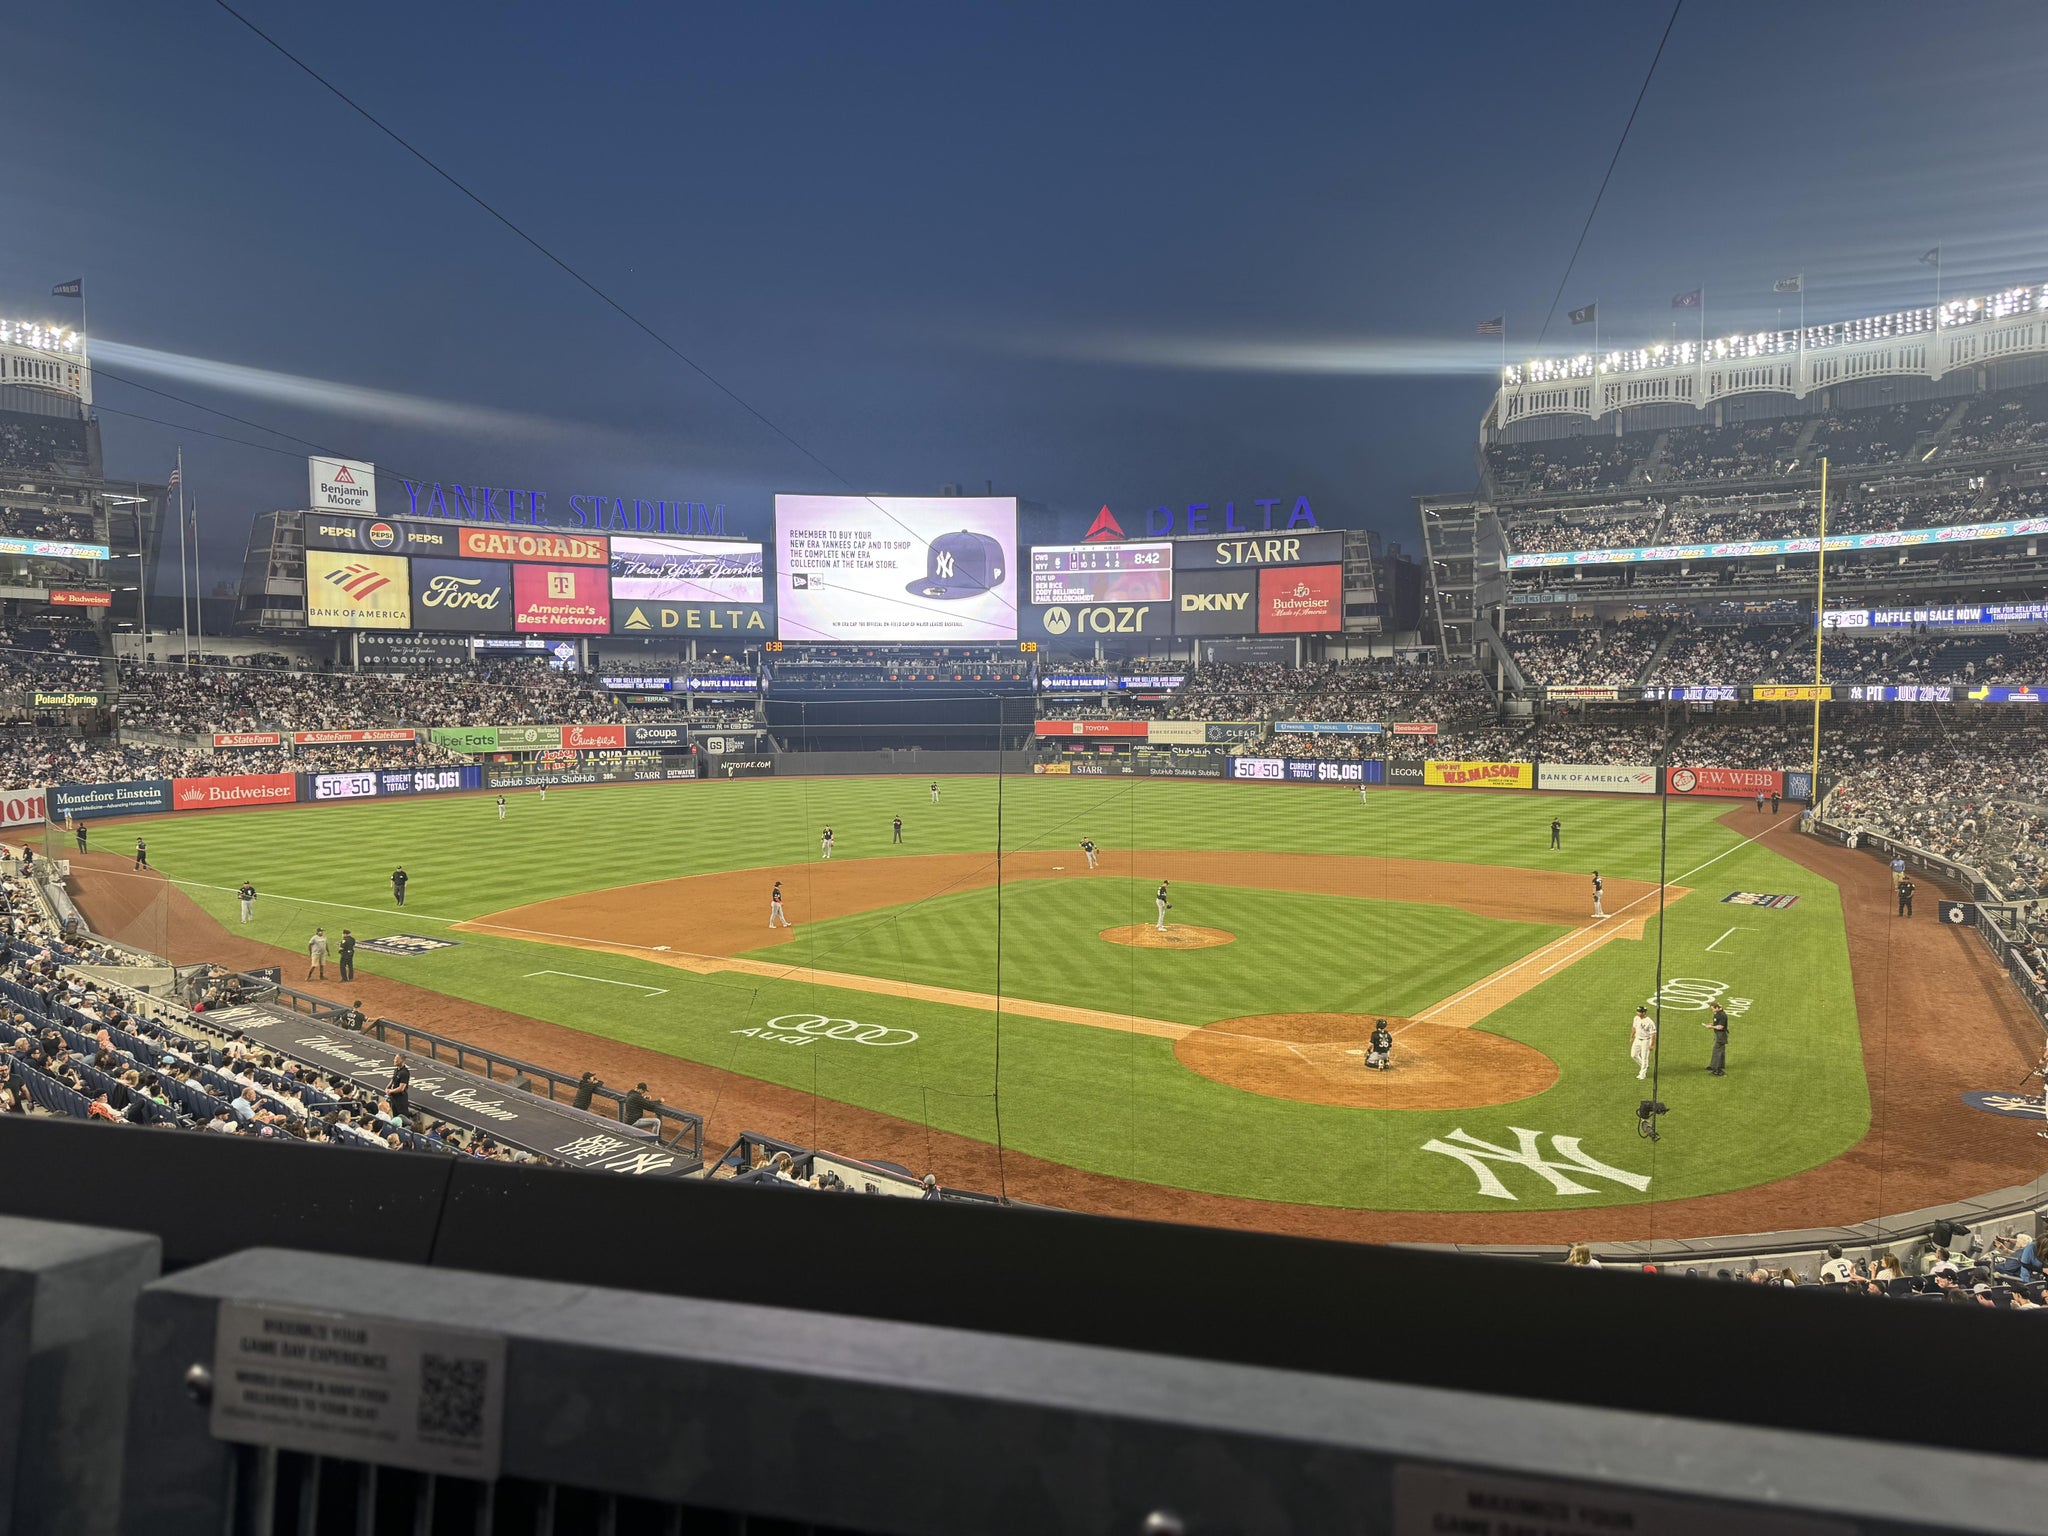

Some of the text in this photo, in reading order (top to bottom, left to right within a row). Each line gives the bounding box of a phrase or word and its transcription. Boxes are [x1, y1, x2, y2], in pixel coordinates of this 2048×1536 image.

[321, 482, 369, 498] Benjamin
[328, 494, 361, 506] Moore
[403, 480, 726, 535] YANKEE STADIUM
[1145, 496, 1318, 536] DELTA
[320, 526, 356, 538] PEPSI
[372, 530, 394, 540] PEPSI
[790, 530, 827, 538] REMEMBER
[408, 533, 443, 545] PEPSI
[790, 540, 805, 548] NEW
[807, 540, 820, 548] ERA
[822, 540, 852, 548] YANKEES
[853, 541, 866, 549] CAP
[884, 542, 892, 550] TO
[468, 534, 602, 558] GATORADE
[1216, 538, 1300, 565] STARR
[790, 550, 802, 558] THE
[804, 550, 838, 558] COMPLETE
[1134, 553, 1160, 564] 8:42
[624, 560, 705, 578] New York
[790, 560, 830, 568] COLLECTION
[856, 560, 874, 568] TEAM
[422, 576, 501, 610] Ford
[69, 595, 110, 604] Budweiser
[1181, 592, 1249, 612] DKNY
[1272, 598, 1329, 610] Budweiser
[310, 608, 406, 619] BANK OF AMERICA
[528, 603, 596, 616] America's
[1875, 608, 1981, 623] RAFFLE ON SALE NOW
[518, 614, 607, 626] Best Network
[661, 609, 766, 630] DELTA
[1078, 607, 1150, 632] razr
[1848, 614, 1863, 625] 50
[766, 641, 783, 652] 0:38
[1020, 642, 1036, 652] 0:38
[1867, 686, 1884, 700] PIT
[1895, 686, 1950, 701] JULY 20-22
[35, 694, 98, 706] Poland Spring
[648, 728, 677, 738] coupa
[465, 735, 494, 745] Eats
[710, 741, 722, 749] GS
[542, 750, 577, 761] Jersey
[721, 761, 771, 769] NITTOTIRE.COM
[1240, 763, 1279, 777] 50 50
[1289, 762, 1316, 770] CURRENT
[1318, 762, 1362, 780] $16,061
[634, 771, 660, 779] STARR
[1293, 770, 1313, 778] TOTAL:
[1390, 768, 1424, 776] LEGORA
[1540, 773, 1567, 781] BANK
[1584, 775, 1630, 783] AMERICA
[382, 774, 412, 783] CURRENT
[414, 772, 459, 791] $16,061
[490, 773, 595, 788] StubHub StubHub StubHub
[1699, 772, 1724, 784] F.W.
[1729, 773, 1772, 786] WEBB
[322, 778, 370, 797] 50 50
[386, 783, 408, 792] TOTAL:
[1791, 782, 1808, 790] YORK
[57, 787, 161, 805] Montefiore Einstein
[347, 1018, 355, 1026] 73
[730, 1027, 819, 1046] Audi
[295, 1035, 365, 1062] Welcome
[432, 1089, 518, 1121] Stadium
[569, 1137, 617, 1156] YORK
[586, 1134, 630, 1148] NEW
[553, 1145, 589, 1160] LIFE
[1420, 1126, 1652, 1200] NY
[1837, 1264, 1849, 1278] 2
